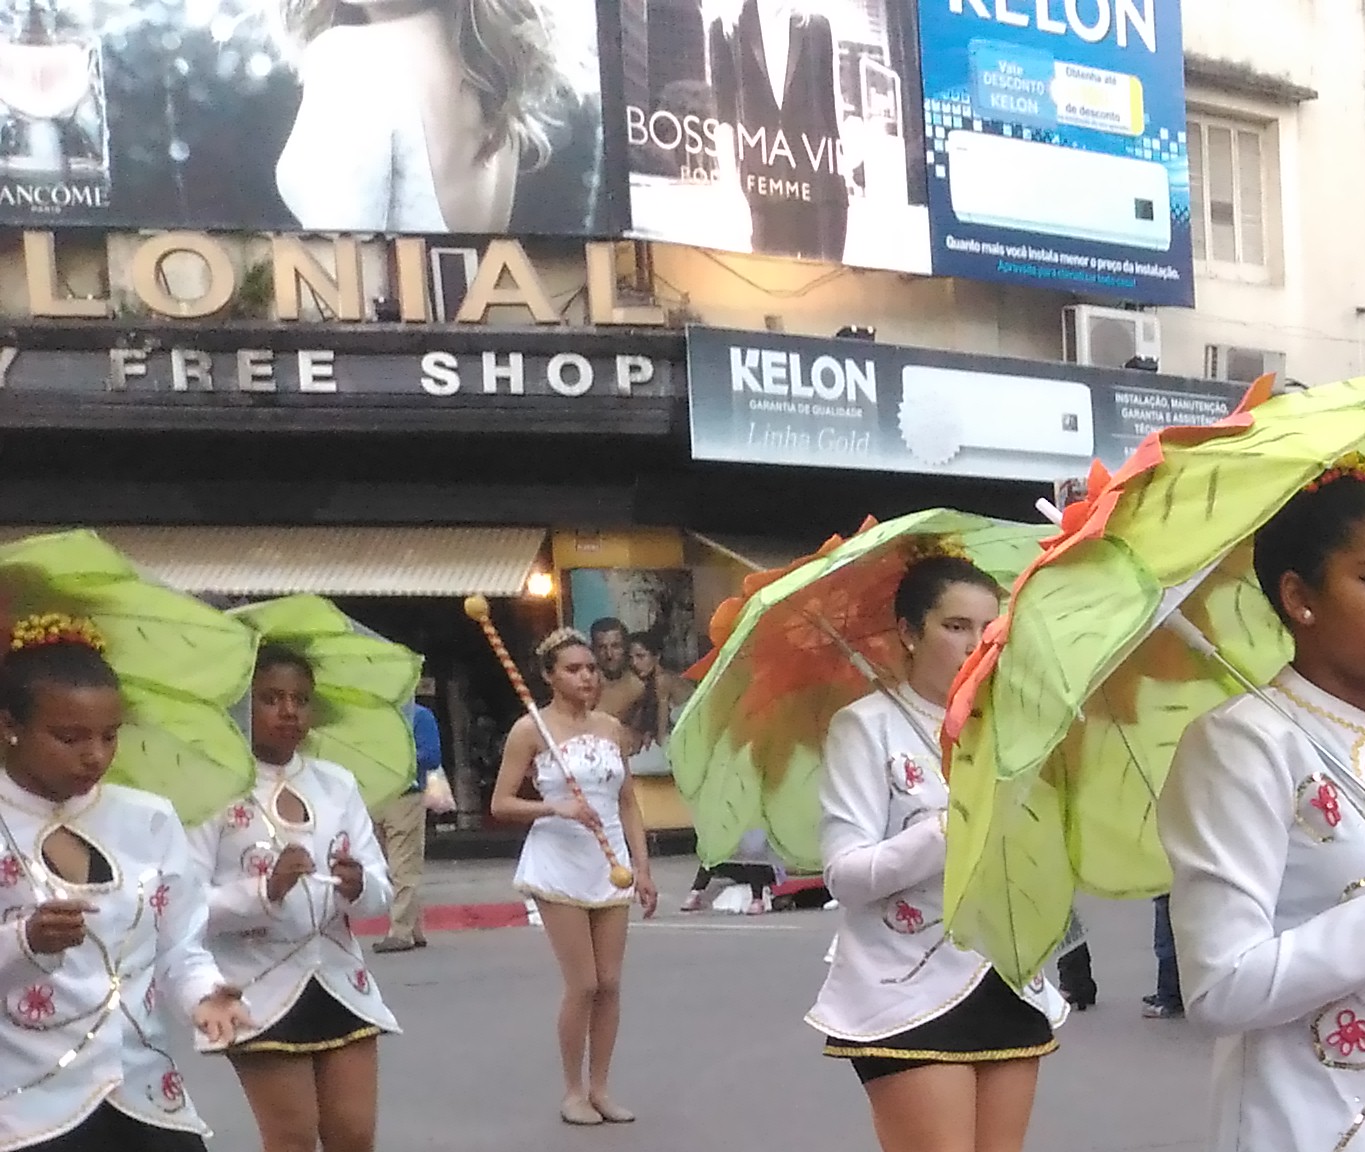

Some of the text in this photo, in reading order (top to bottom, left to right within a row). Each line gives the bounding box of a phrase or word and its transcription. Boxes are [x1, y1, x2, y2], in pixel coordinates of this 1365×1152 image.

[983, 71, 1045, 96] DESCONTO
[991, 93, 1039, 114] KELON
[1065, 103, 1077, 113] de
[1079, 106, 1121, 122] desconto
[626, 105, 722, 158] BOSS
[736, 122, 797, 169] MA
[747, 174, 812, 202] FEMME
[945, 234, 982, 253] Quanto
[981, 242, 1006, 257] mais
[1005, 245, 1028, 260] você
[1058, 253, 1090, 268] menor
[1089, 257, 1097, 269] o
[1097, 258, 1124, 274] preço
[1122, 260, 1136, 274] da
[23, 229, 666, 326] LONIAL
[108, 349, 655, 397] FREE SHOP
[729, 346, 878, 404] KELON
[749, 399, 864, 418] GARANTIA DE QUALIDADE
[1114, 392, 1230, 416] INSTALAÇÃO, MANUTENÇÃO,
[1121, 407, 1222, 426] GARANTIA E ASSISTÊNC
[748, 421, 871, 454] Linha Gold
